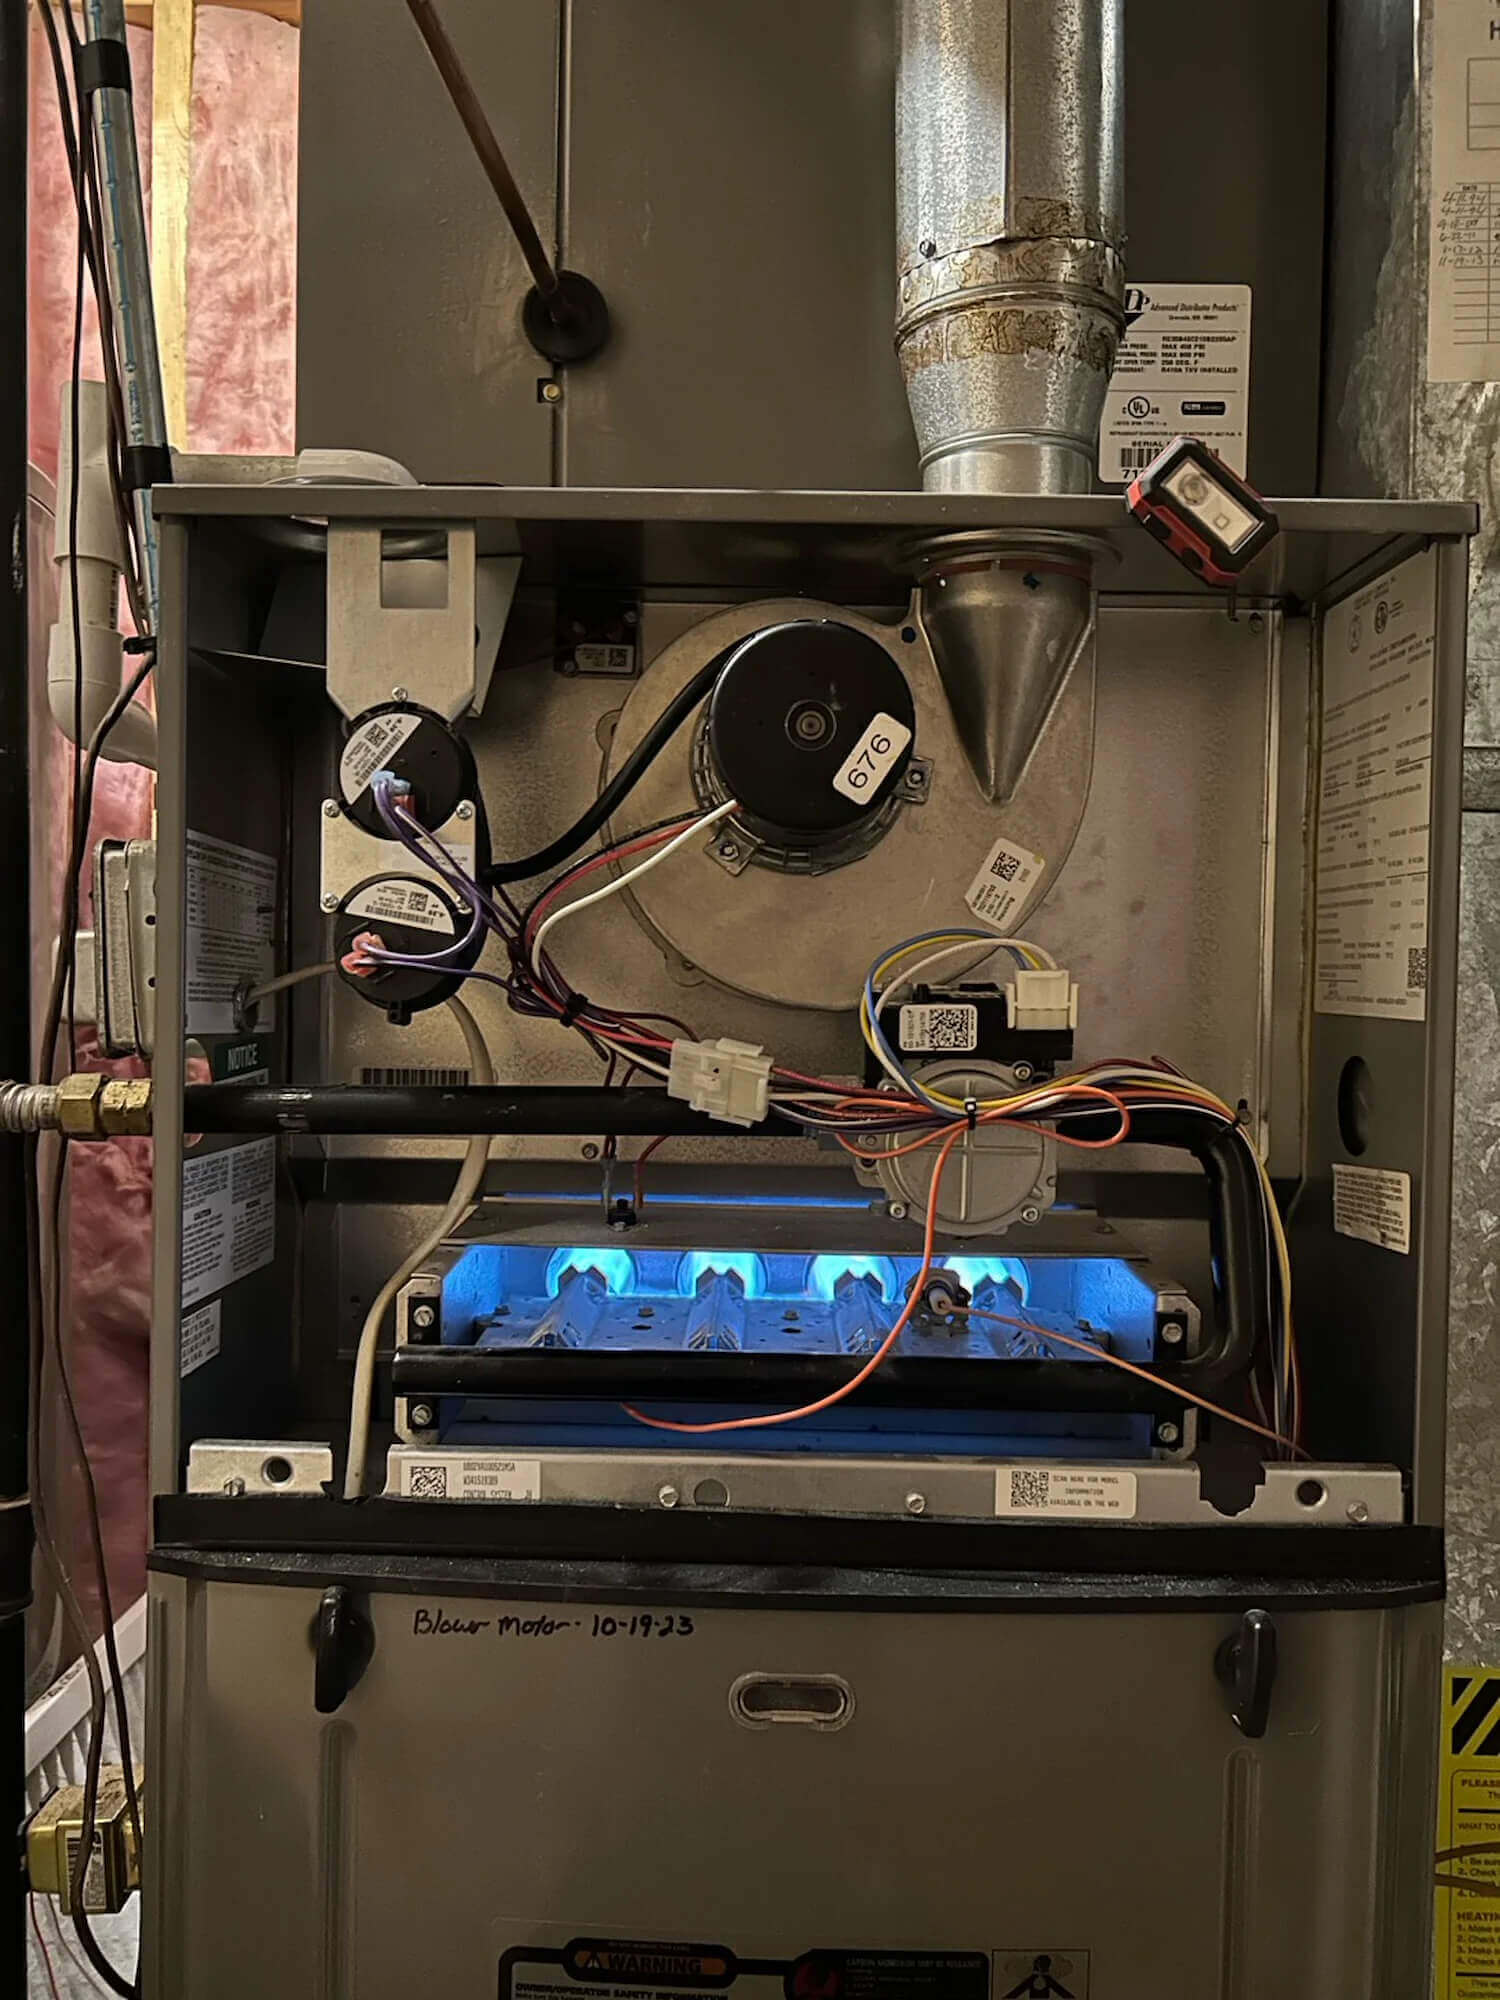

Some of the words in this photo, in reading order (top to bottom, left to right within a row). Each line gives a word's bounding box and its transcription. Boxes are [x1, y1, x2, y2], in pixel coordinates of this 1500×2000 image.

[849, 733, 891, 789] 676
[227, 1043, 258, 1072] NOTICE
[609, 1952, 703, 1976] WARNING
